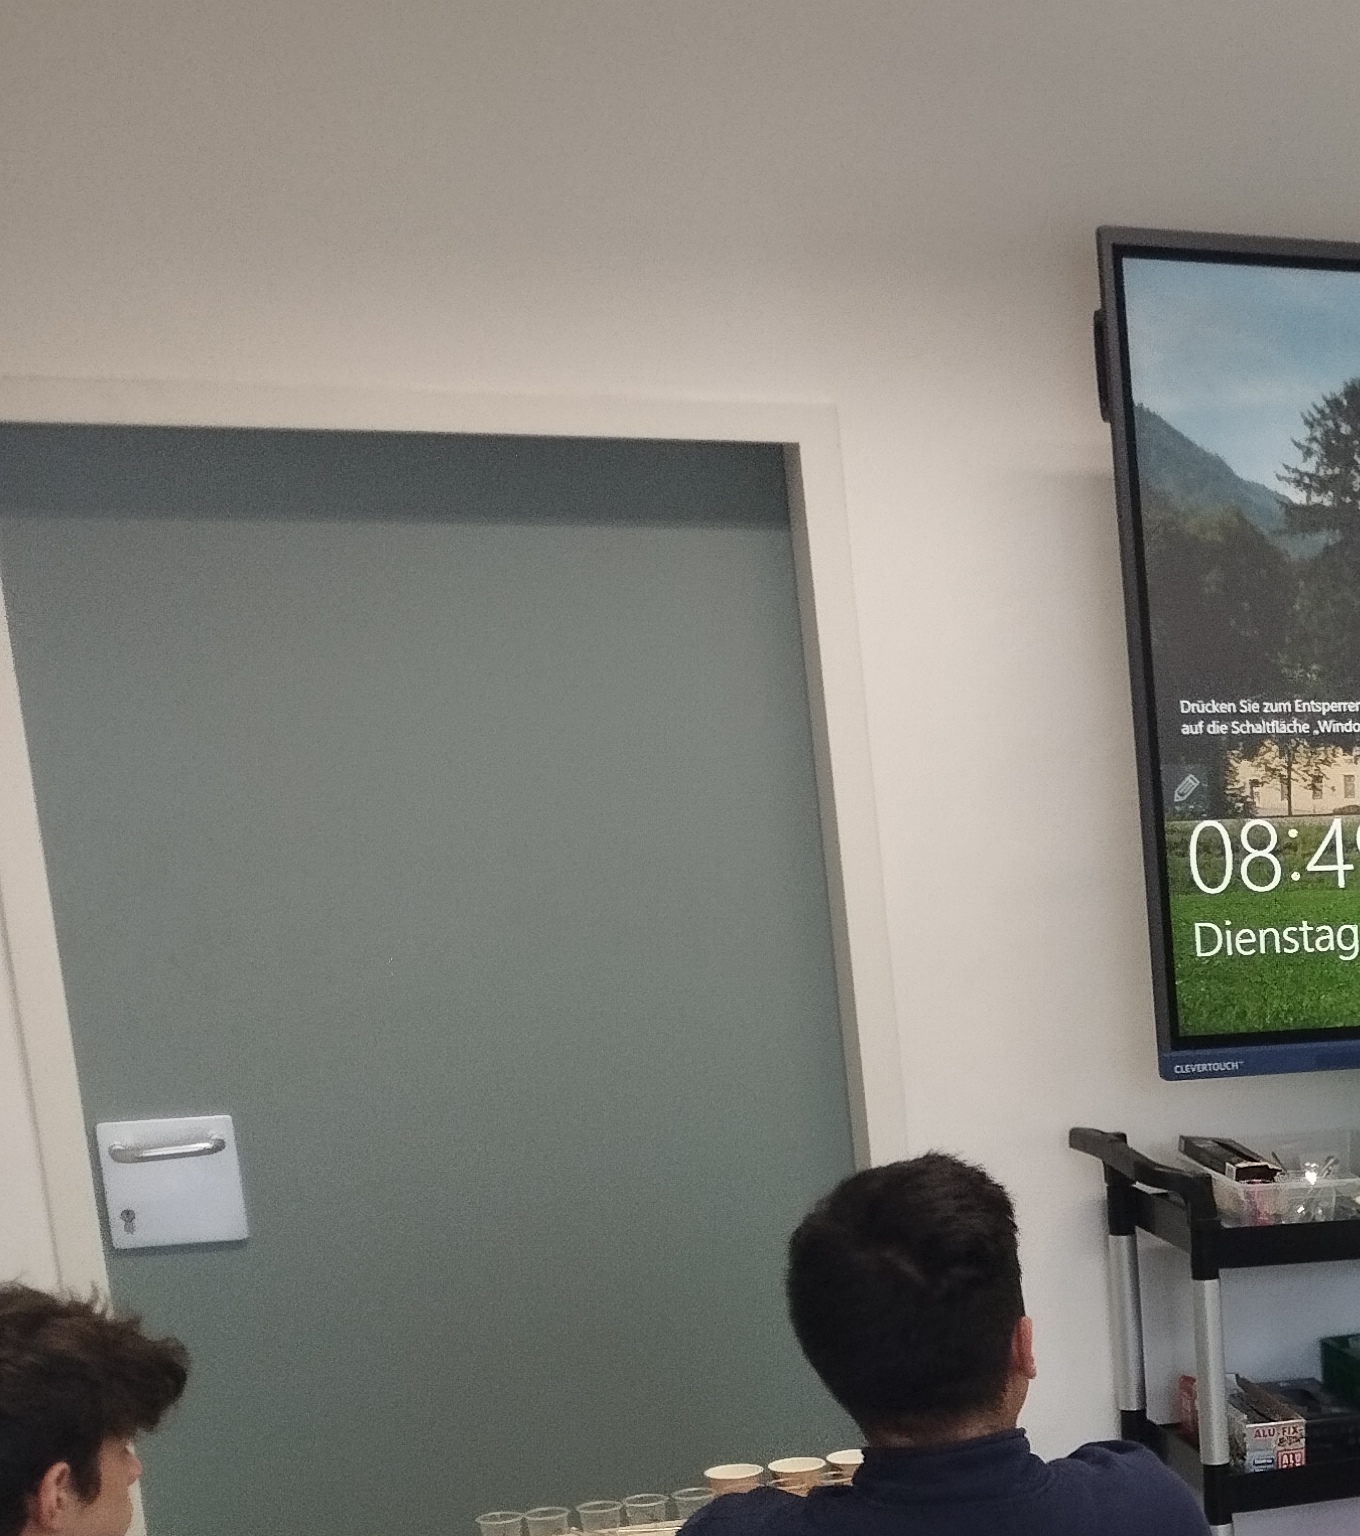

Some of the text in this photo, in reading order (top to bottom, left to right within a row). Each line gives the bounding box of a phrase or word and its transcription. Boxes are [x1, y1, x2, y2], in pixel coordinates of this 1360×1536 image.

[1180, 699, 1237, 714] Drücken
[1240, 700, 1260, 713] Sie
[1263, 703, 1291, 713] zum
[1181, 721, 1204, 735] auf
[1207, 720, 1229, 735] die
[1231, 719, 1310, 735] Schaltfläche
